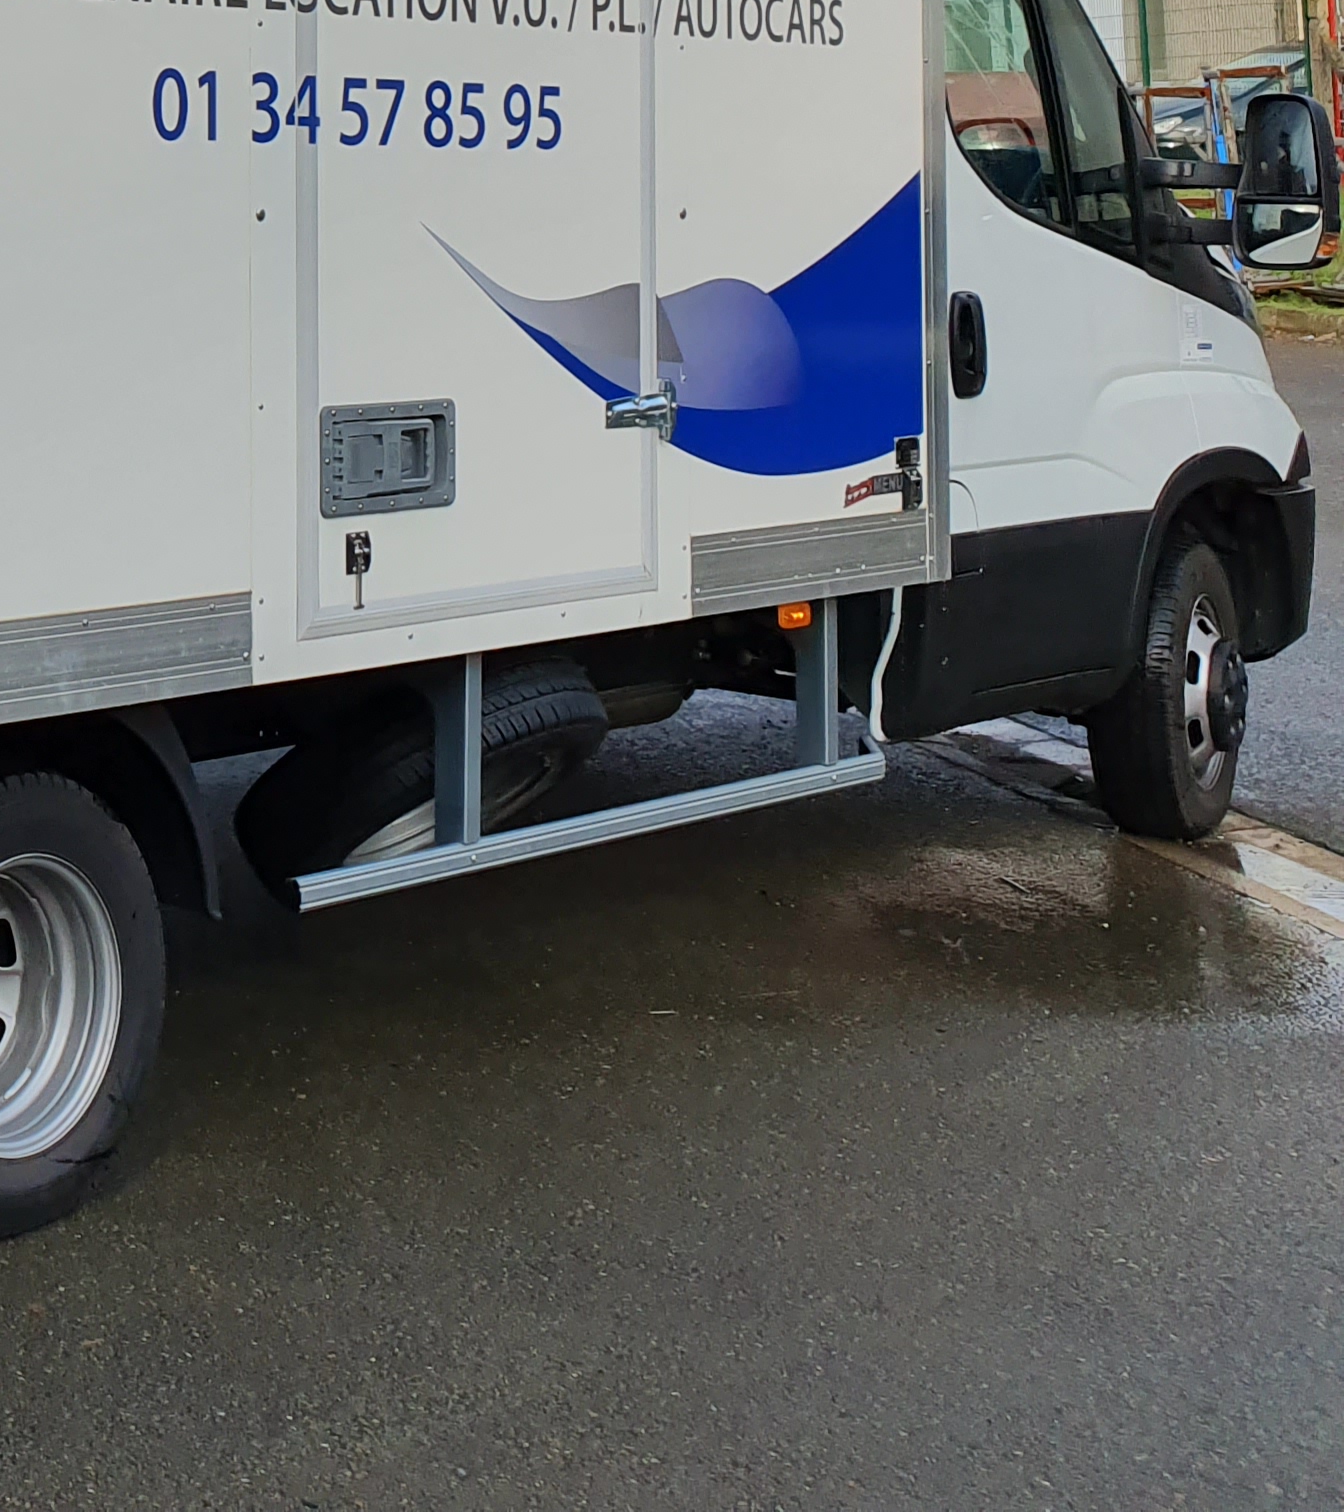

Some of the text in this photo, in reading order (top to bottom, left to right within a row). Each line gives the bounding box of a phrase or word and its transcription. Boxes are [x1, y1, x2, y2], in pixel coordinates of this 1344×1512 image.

[152, 67, 562, 150] 01 34 57 85 95
